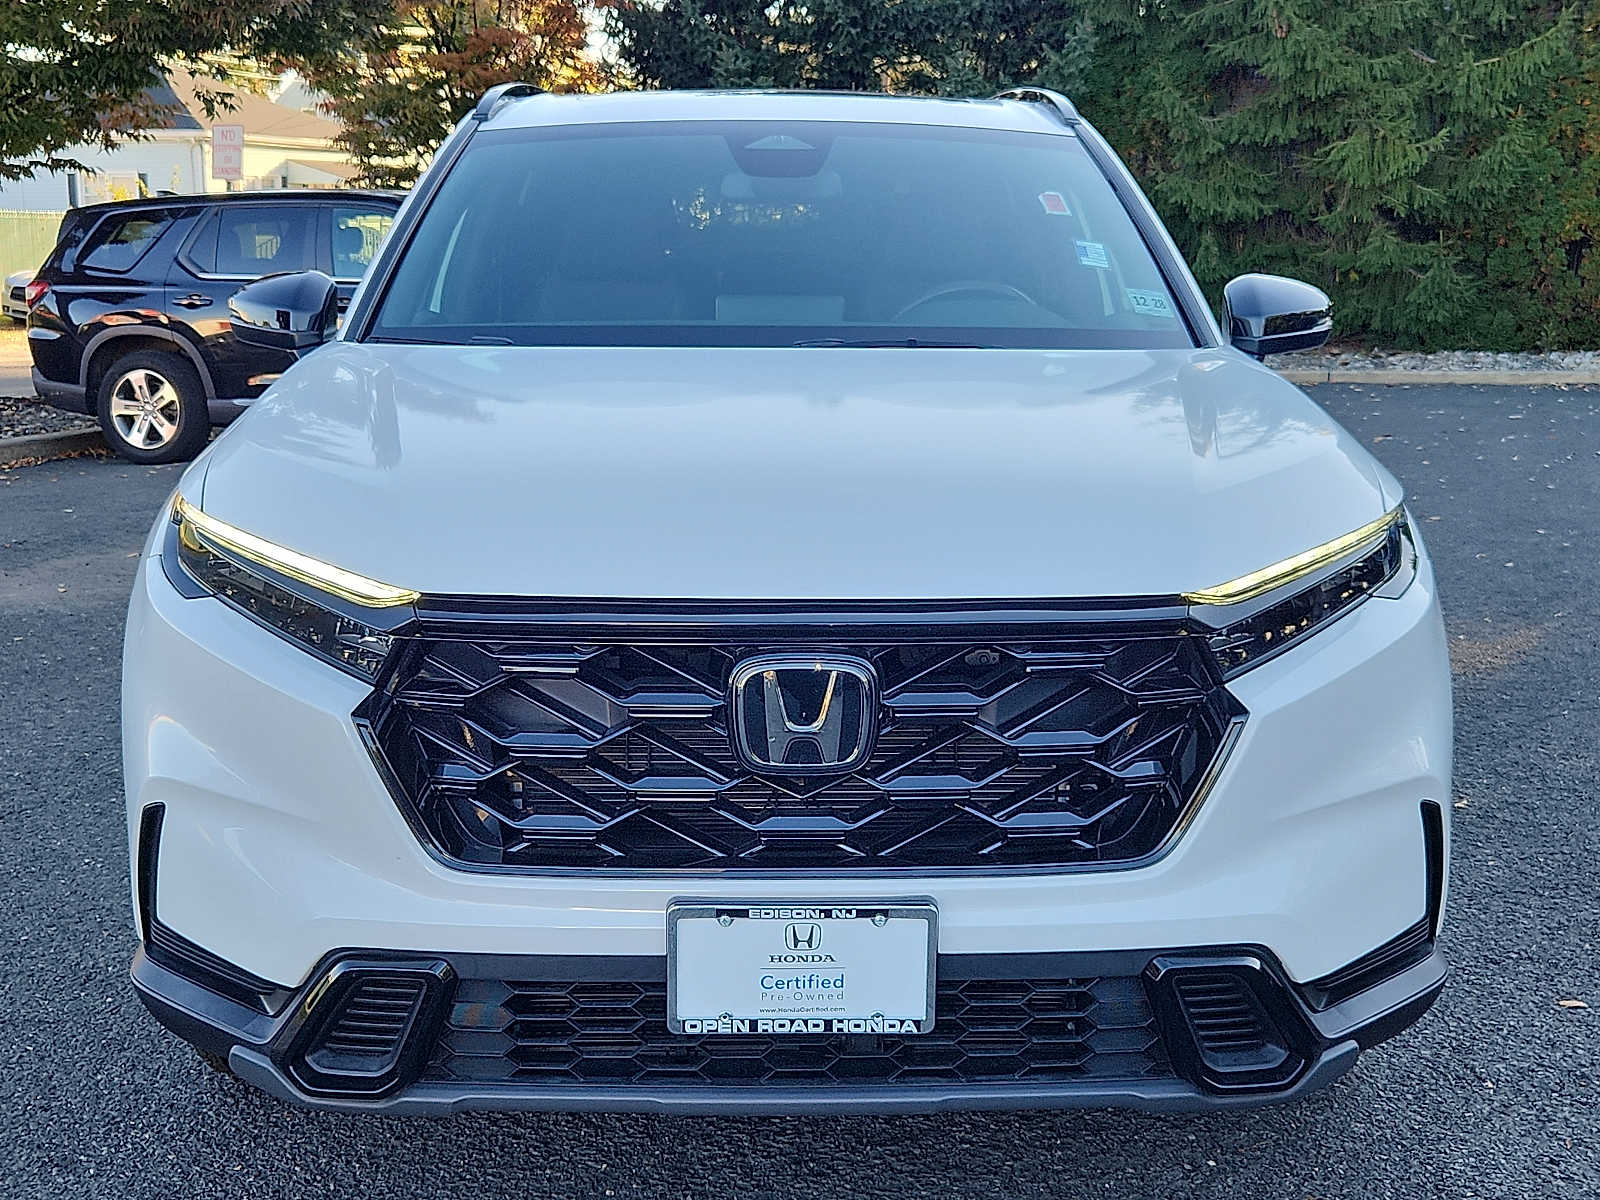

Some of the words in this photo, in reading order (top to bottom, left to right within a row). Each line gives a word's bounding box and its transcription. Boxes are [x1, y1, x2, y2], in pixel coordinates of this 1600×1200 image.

[1132, 295, 1149, 307] 12
[748, 908, 825, 919] EDISON,
[832, 908, 857, 919] NJ
[769, 954, 836, 963] HONDA
[761, 974, 845, 989] Certified
[761, 991, 844, 1001] Pre-Owned
[684, 1019, 750, 1033] OPEN
[757, 1019, 825, 1033] ROAD
[833, 1019, 918, 1033] HONDA
